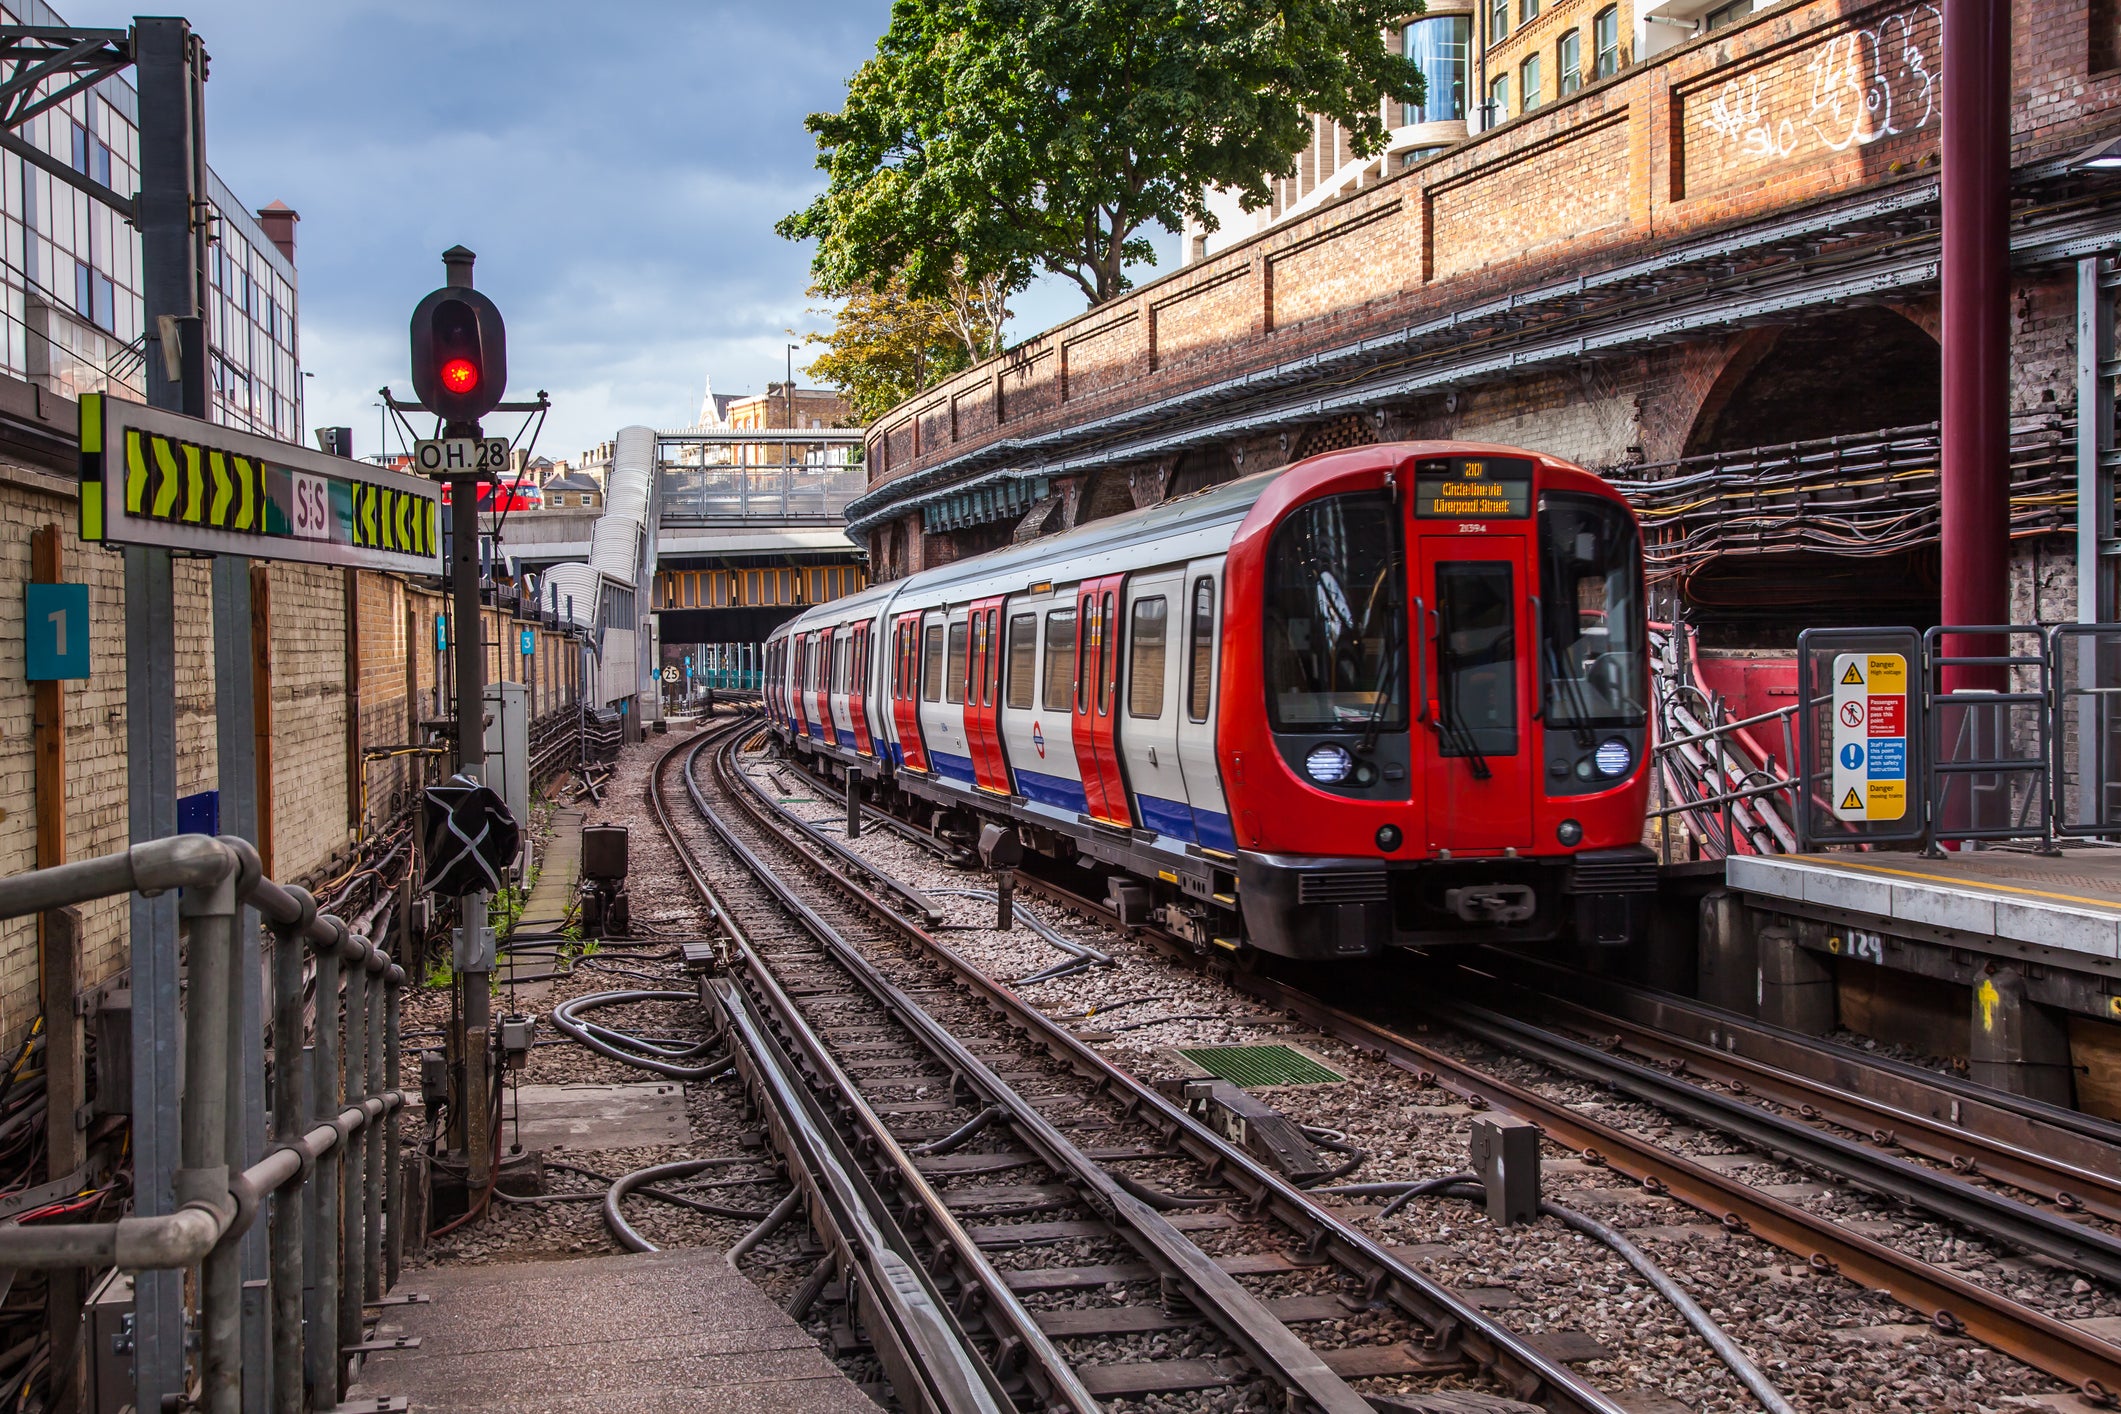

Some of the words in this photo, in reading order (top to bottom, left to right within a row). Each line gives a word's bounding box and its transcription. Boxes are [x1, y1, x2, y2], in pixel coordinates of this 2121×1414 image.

[1433, 499, 1479, 515] Liverpool
[48, 608, 67, 656] 1
[440, 625, 446, 642] 2
[524, 637, 531, 649] 3
[1870, 661, 1894, 669] Danger
[665, 669, 678, 680] 25
